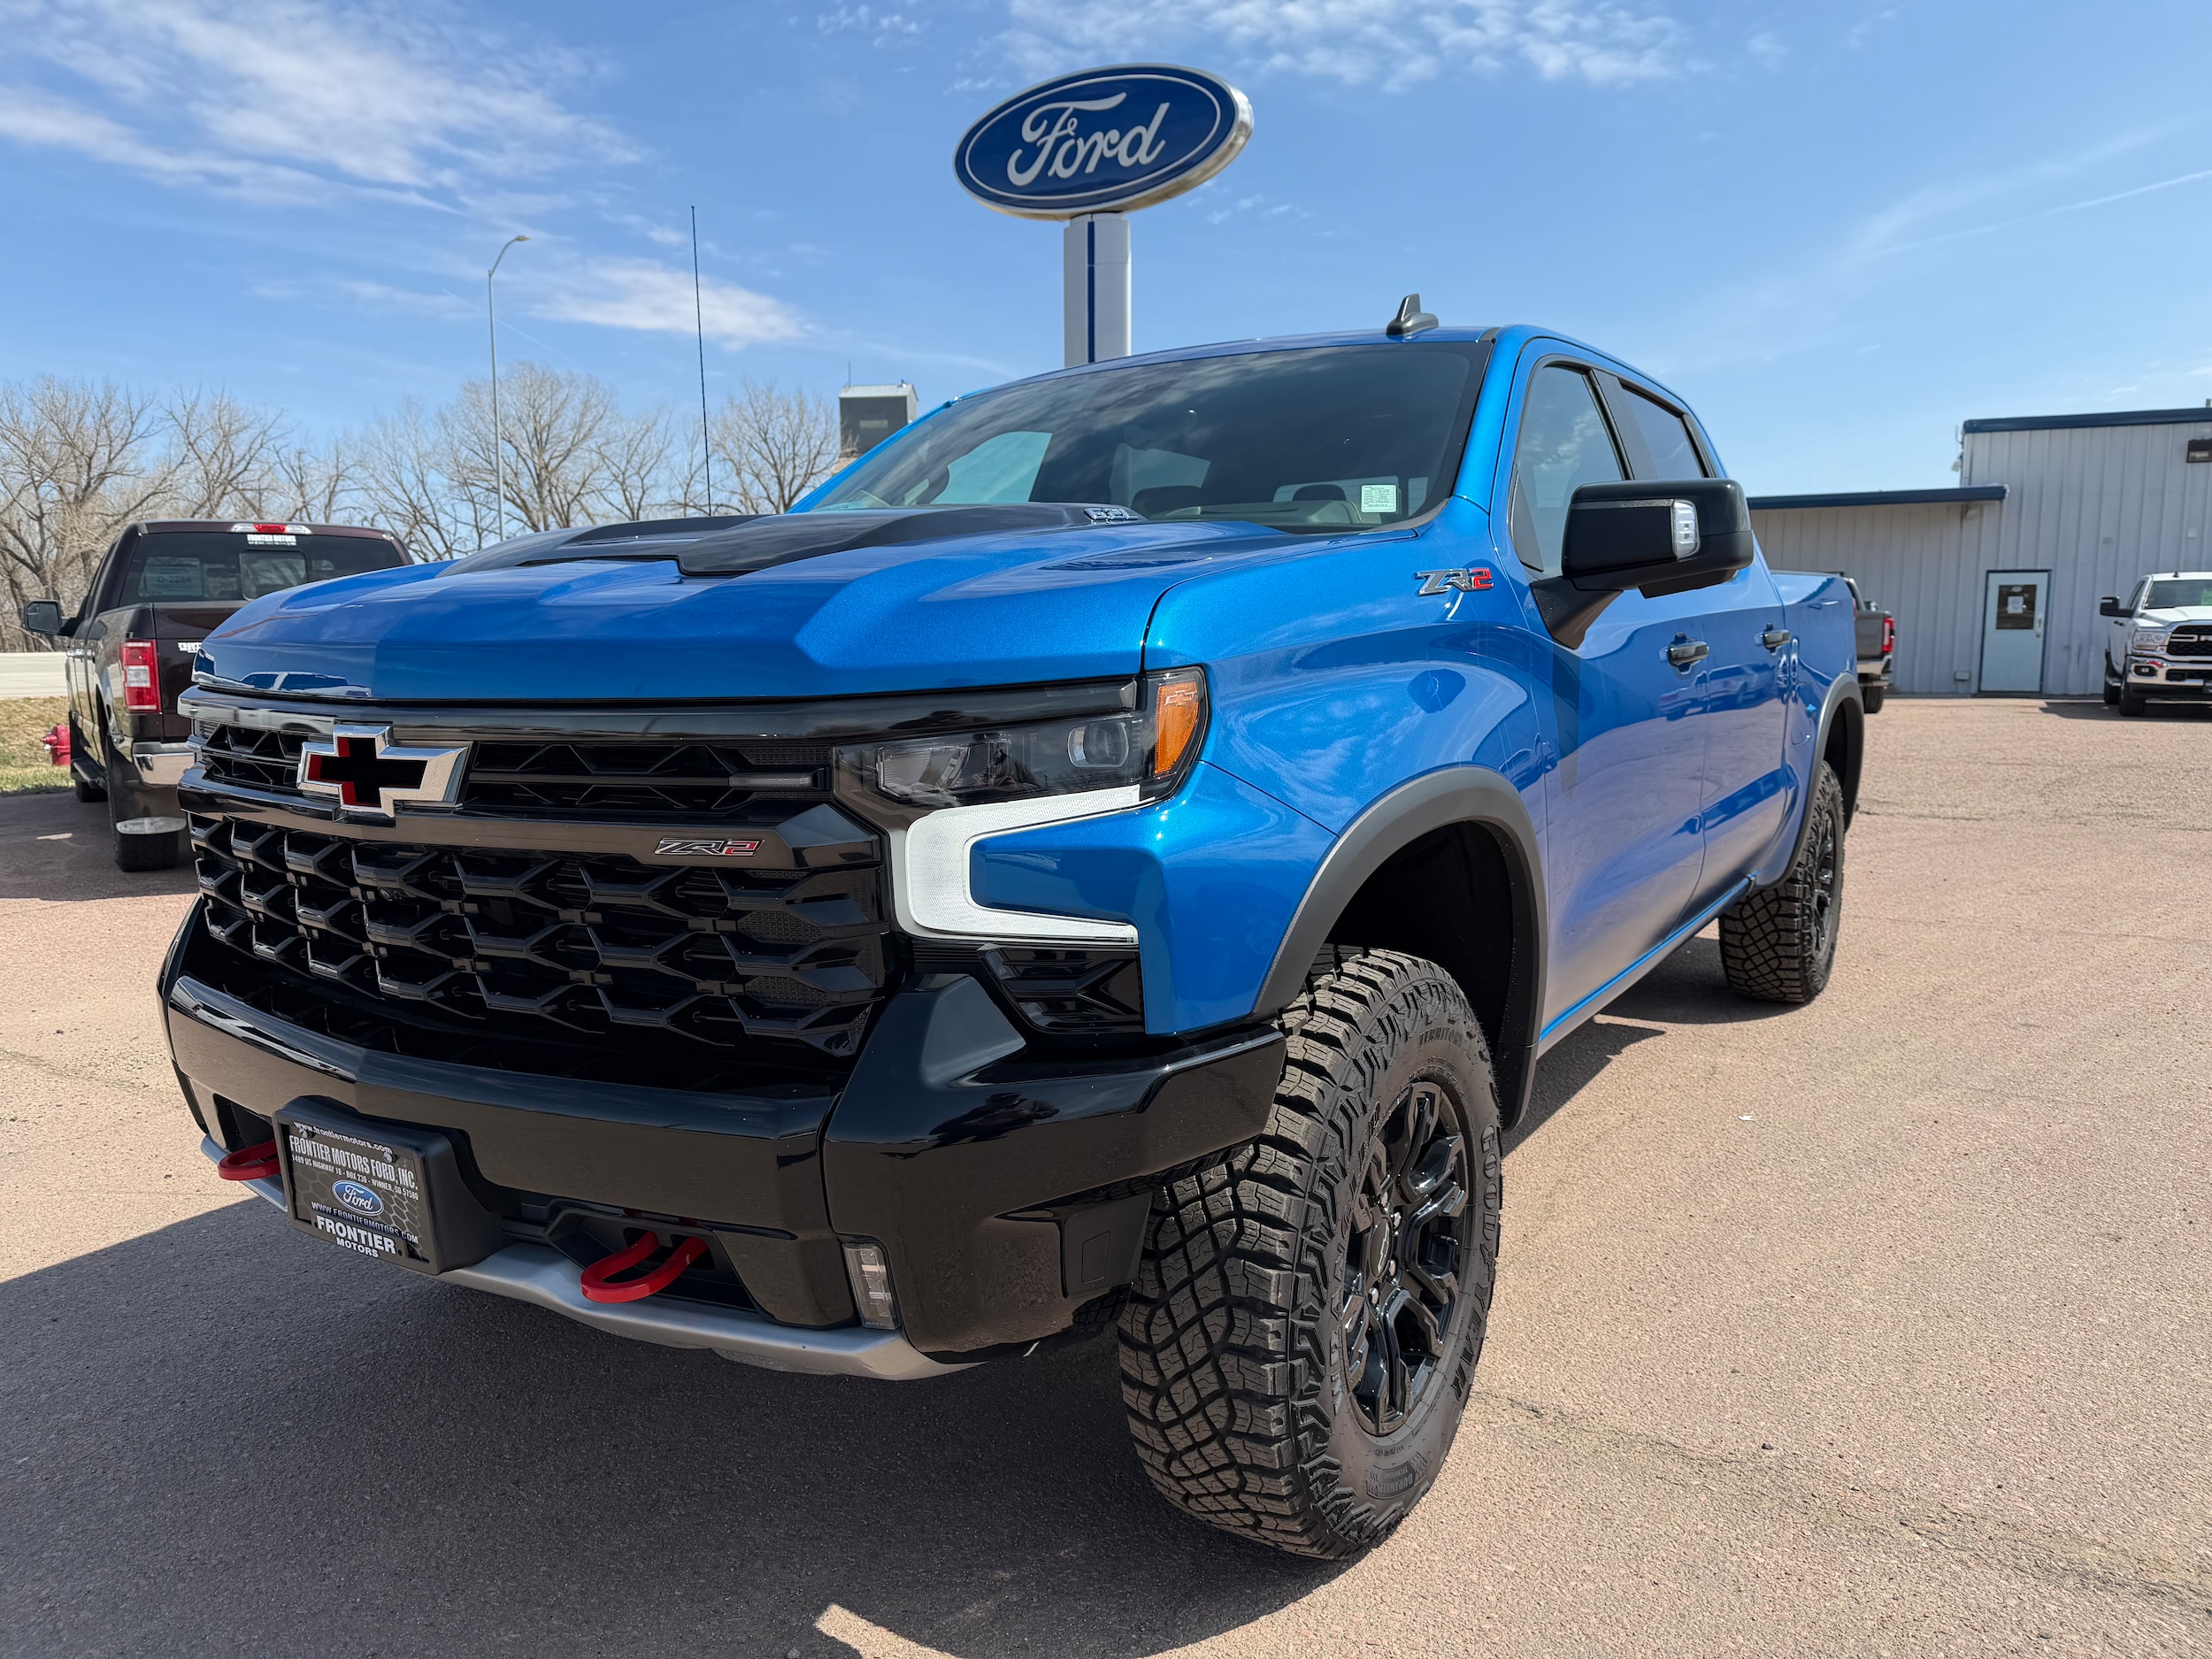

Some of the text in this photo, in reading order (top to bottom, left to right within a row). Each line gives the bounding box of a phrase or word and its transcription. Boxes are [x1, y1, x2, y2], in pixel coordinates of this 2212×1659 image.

[1007, 92, 1170, 186] Ford
[1414, 567, 1494, 596] ZR2
[654, 837, 764, 856] ZR2
[1419, 1026, 1463, 1048] TERRITORY
[294, 1121, 393, 1154] www.frontiermotors.com
[289, 1135, 331, 1164] FRONTIER
[332, 1148, 370, 1173] MOTORS
[398, 1167, 418, 1190] INC.
[292, 1155, 304, 1164] 1489
[313, 1159, 334, 1172] HIGHWAY
[346, 1170, 357, 1180] BOX
[357, 1172, 367, 1184] 230
[395, 1185, 402, 1194] SD
[343, 1185, 373, 1210] Ford
[311, 1202, 419, 1244] WWW.FRONTIERMOTORS.COM
[316, 1215, 396, 1255] FRONTIER
[336, 1238, 379, 1258] MOTORS
[1451, 1124, 1497, 1401] GOODYEAR
